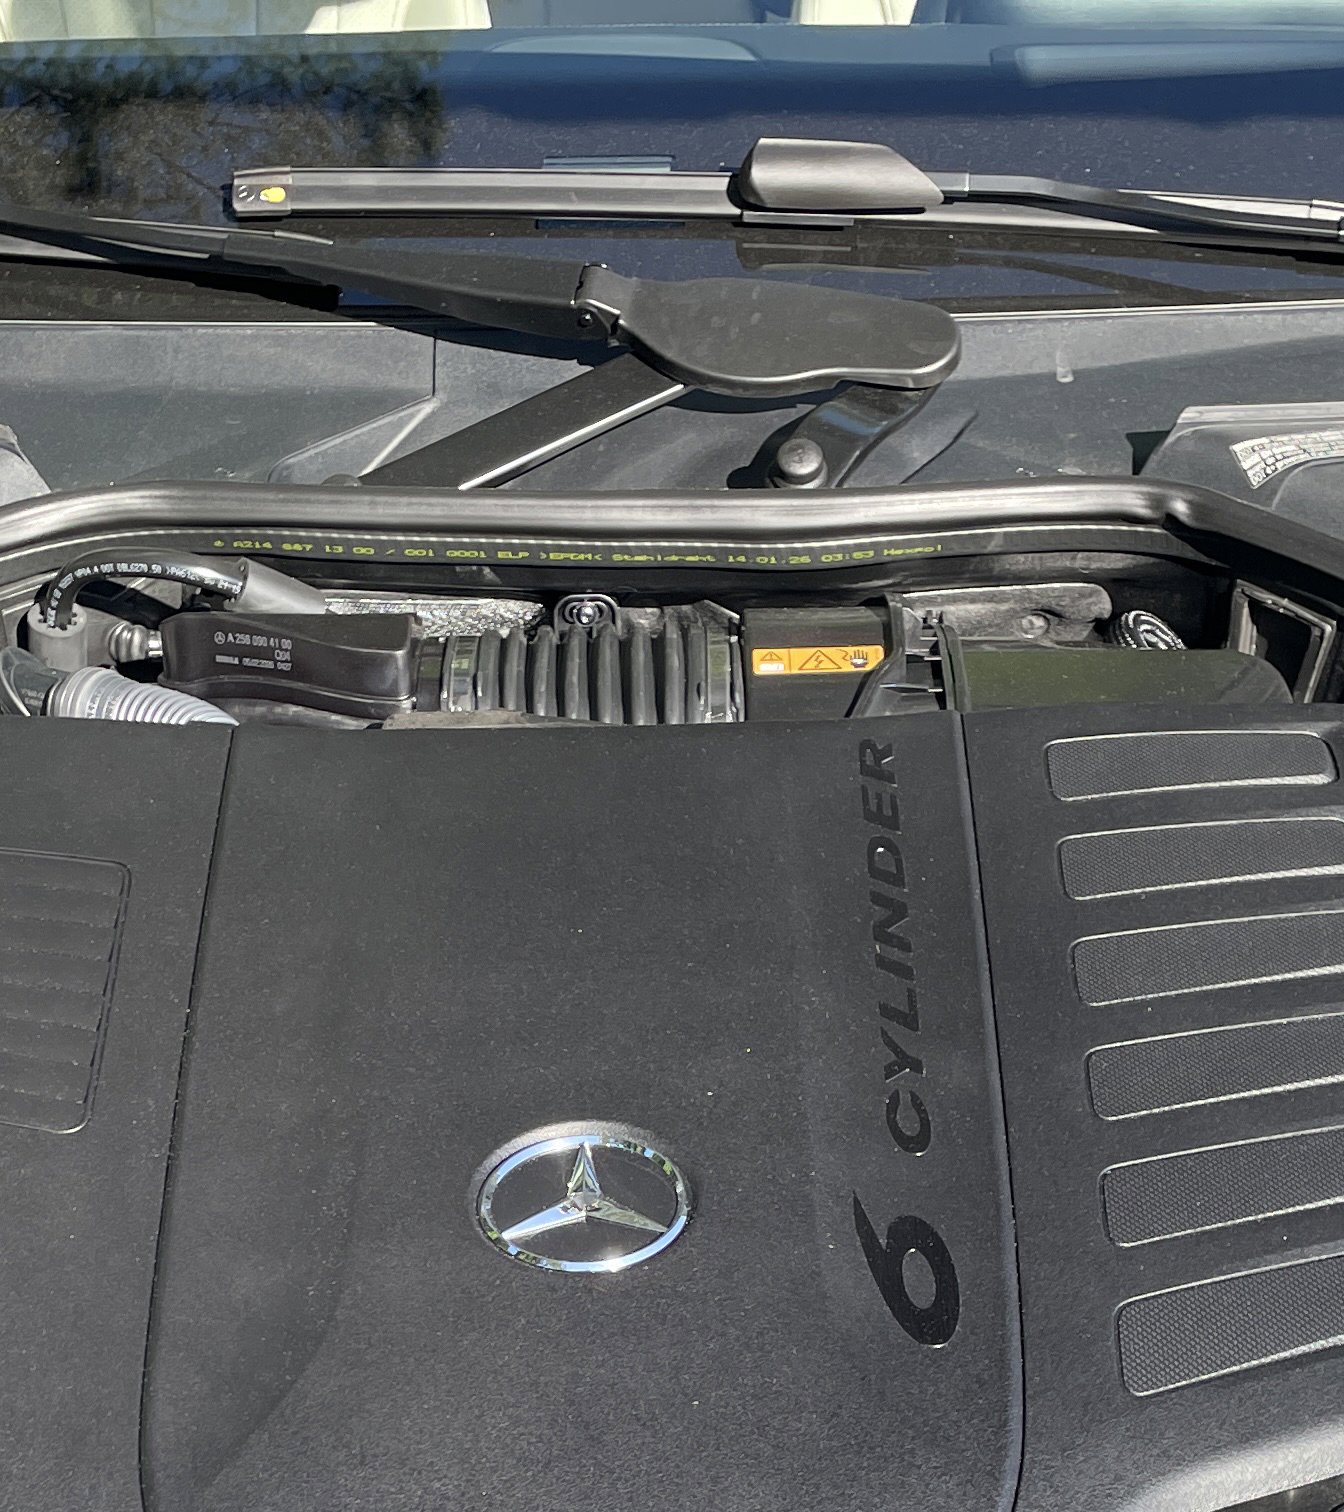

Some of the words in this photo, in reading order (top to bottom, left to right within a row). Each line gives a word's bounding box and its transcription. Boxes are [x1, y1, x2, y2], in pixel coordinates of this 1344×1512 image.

[227, 632, 235, 642] A
[859, 738, 932, 1155] CYLINDER
[853, 1189, 960, 1347] 6
